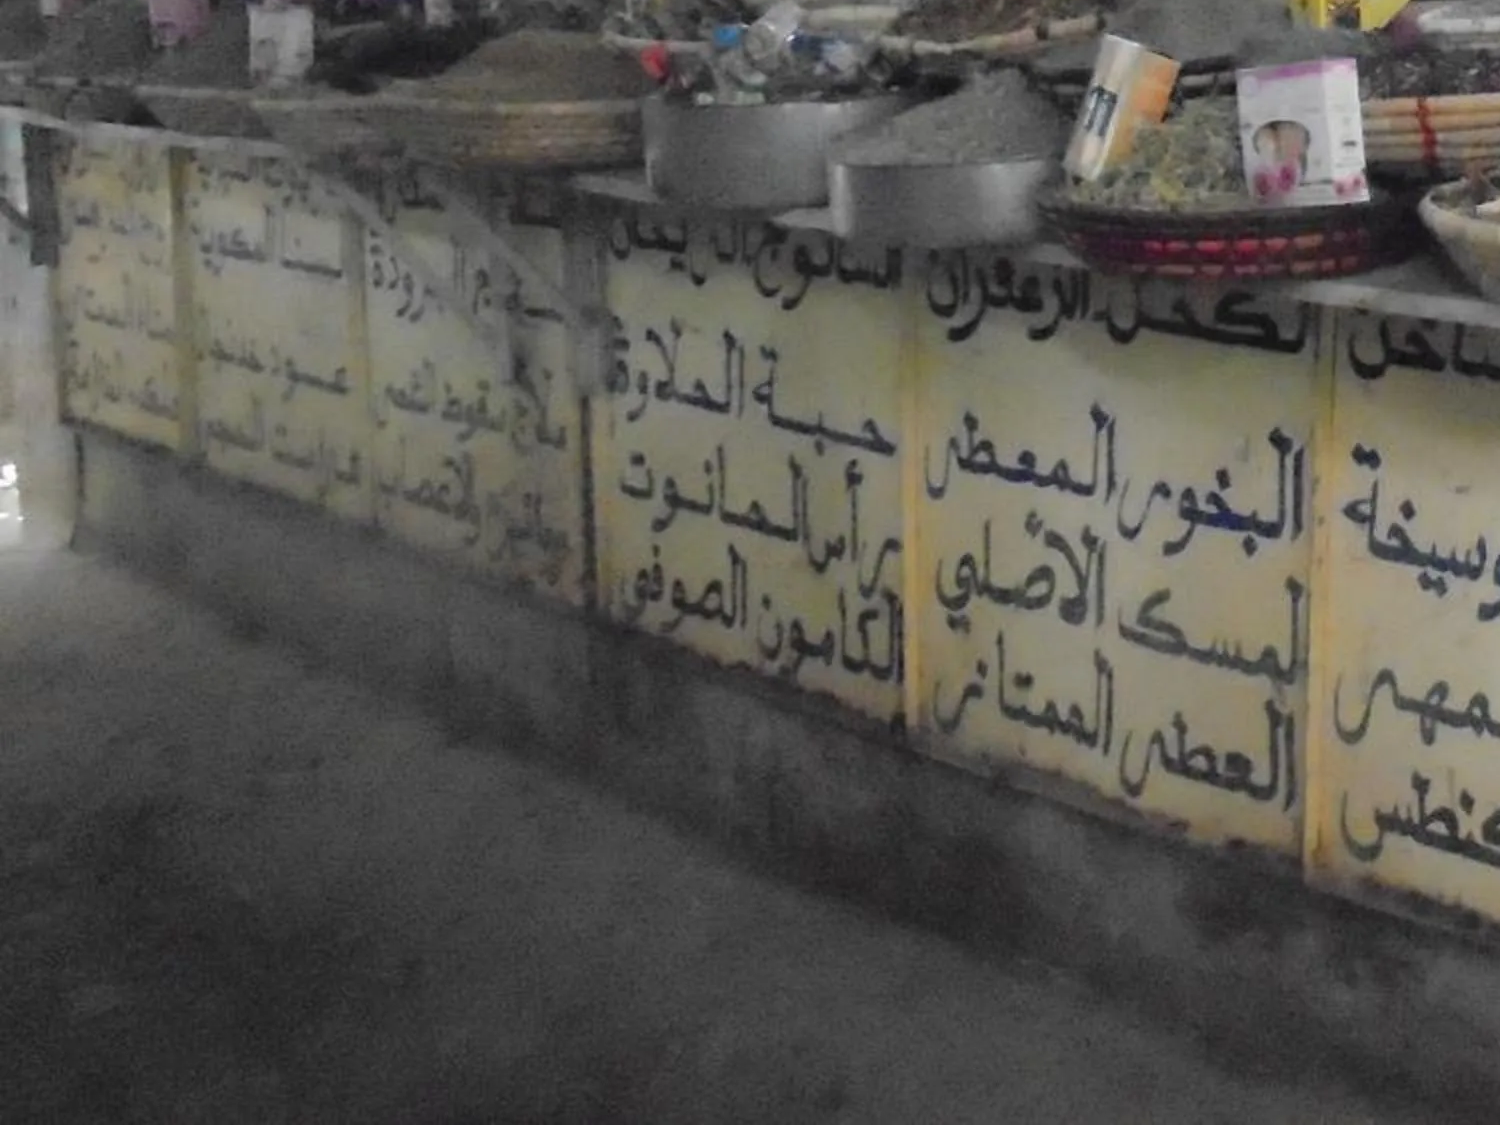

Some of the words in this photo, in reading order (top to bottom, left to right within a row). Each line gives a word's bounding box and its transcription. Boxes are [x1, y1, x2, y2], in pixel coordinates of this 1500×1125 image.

[925, 403, 1117, 505] المعطر
[1118, 426, 1303, 556] البخور
[932, 630, 1116, 758] الممتاز
[1120, 696, 1297, 813] العطر
